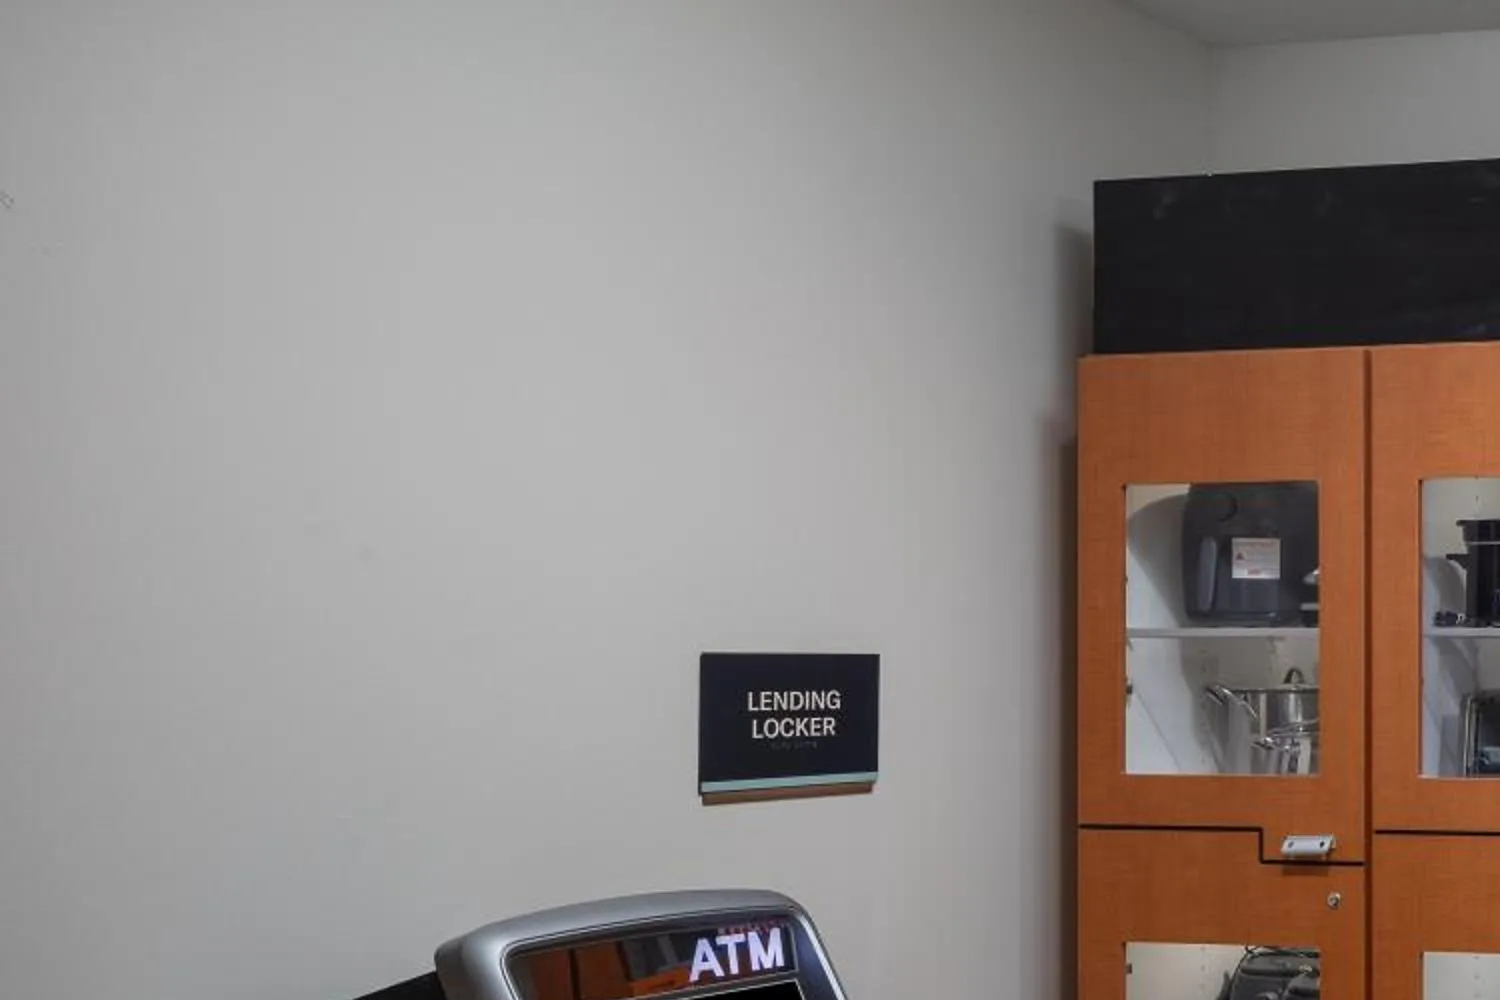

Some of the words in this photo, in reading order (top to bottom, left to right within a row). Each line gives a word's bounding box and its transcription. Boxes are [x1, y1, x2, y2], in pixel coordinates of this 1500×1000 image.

[747, 690, 841, 711] LENDING
[752, 717, 836, 738] LOCKER
[689, 927, 784, 982] ATM
